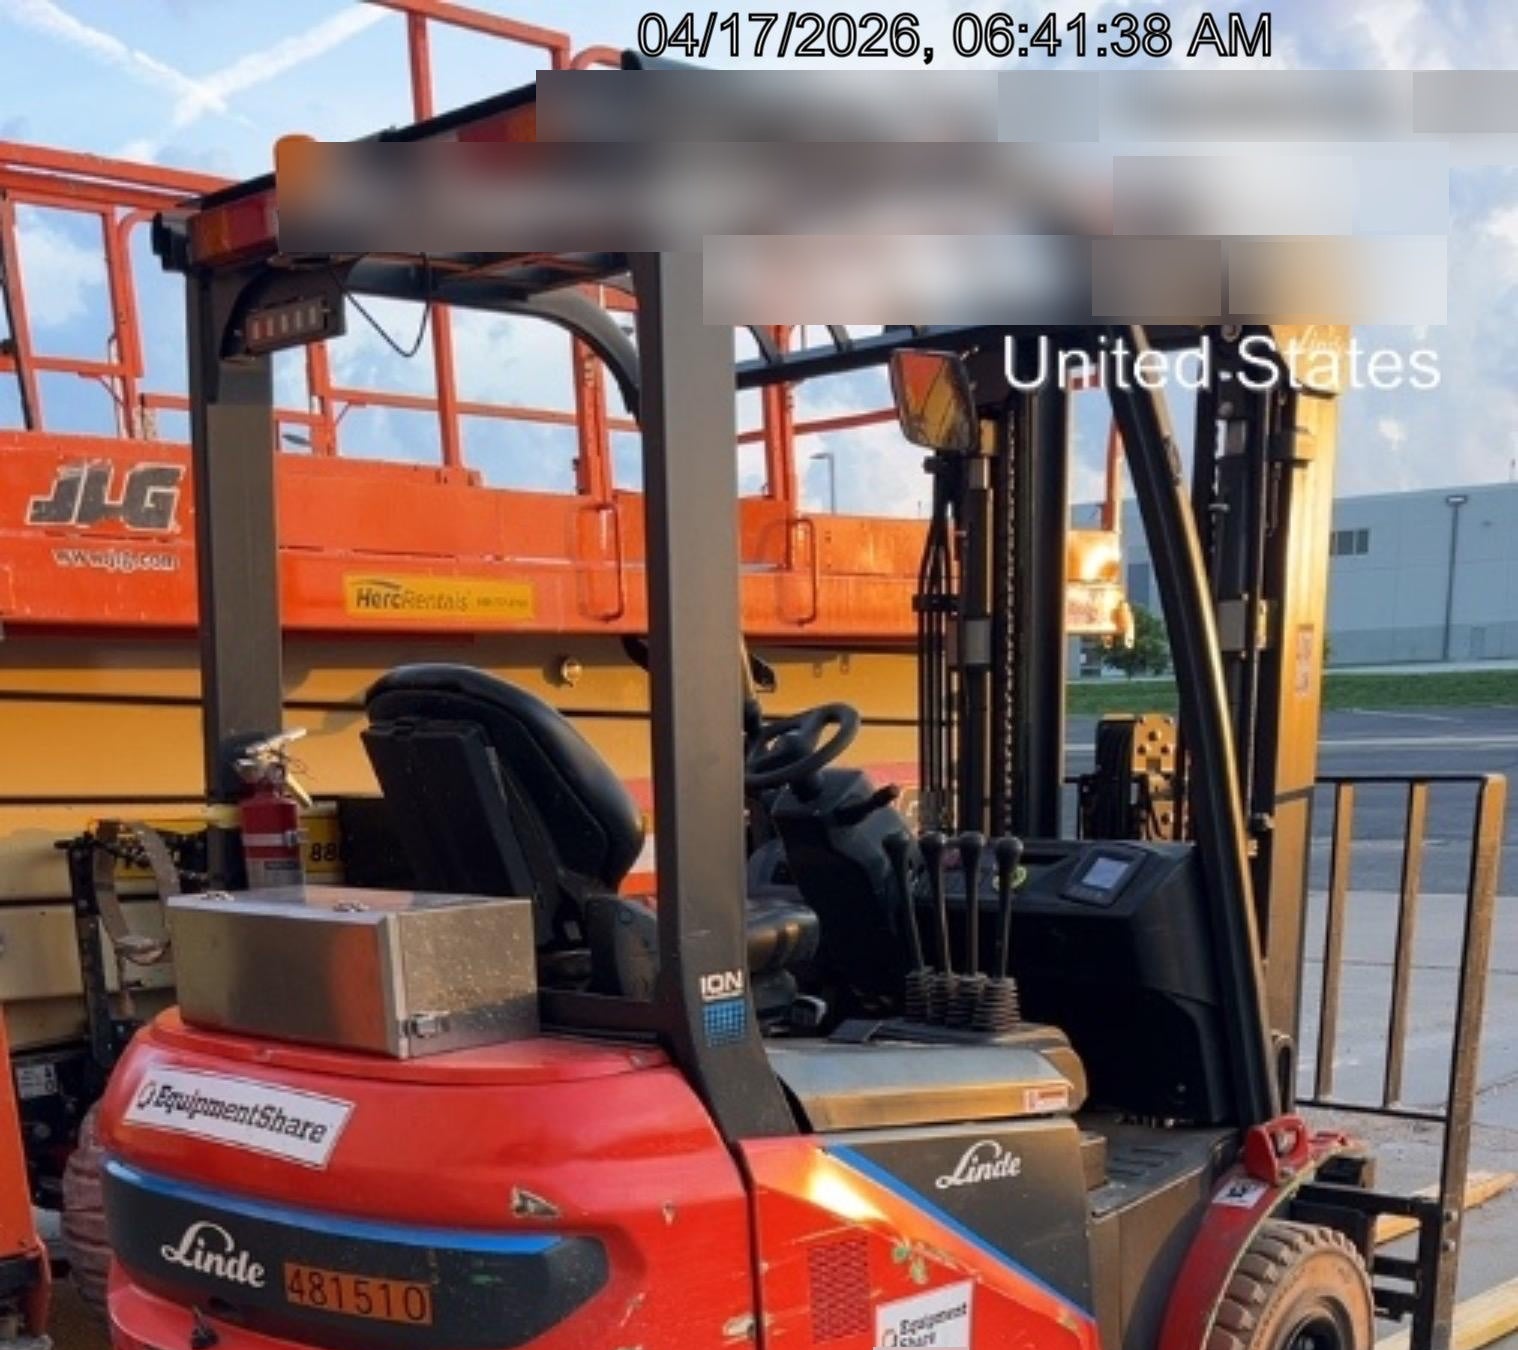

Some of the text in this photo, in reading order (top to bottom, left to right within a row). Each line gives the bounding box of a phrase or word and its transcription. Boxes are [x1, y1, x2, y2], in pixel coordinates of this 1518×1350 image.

[24, 459, 186, 534] JLG
[700, 968, 743, 995] ION
[153, 1084, 329, 1144] EquipmentShare
[934, 1139, 1023, 1189] Linde
[160, 1220, 266, 1288] Linde
[287, 1268, 427, 1321] 481510
